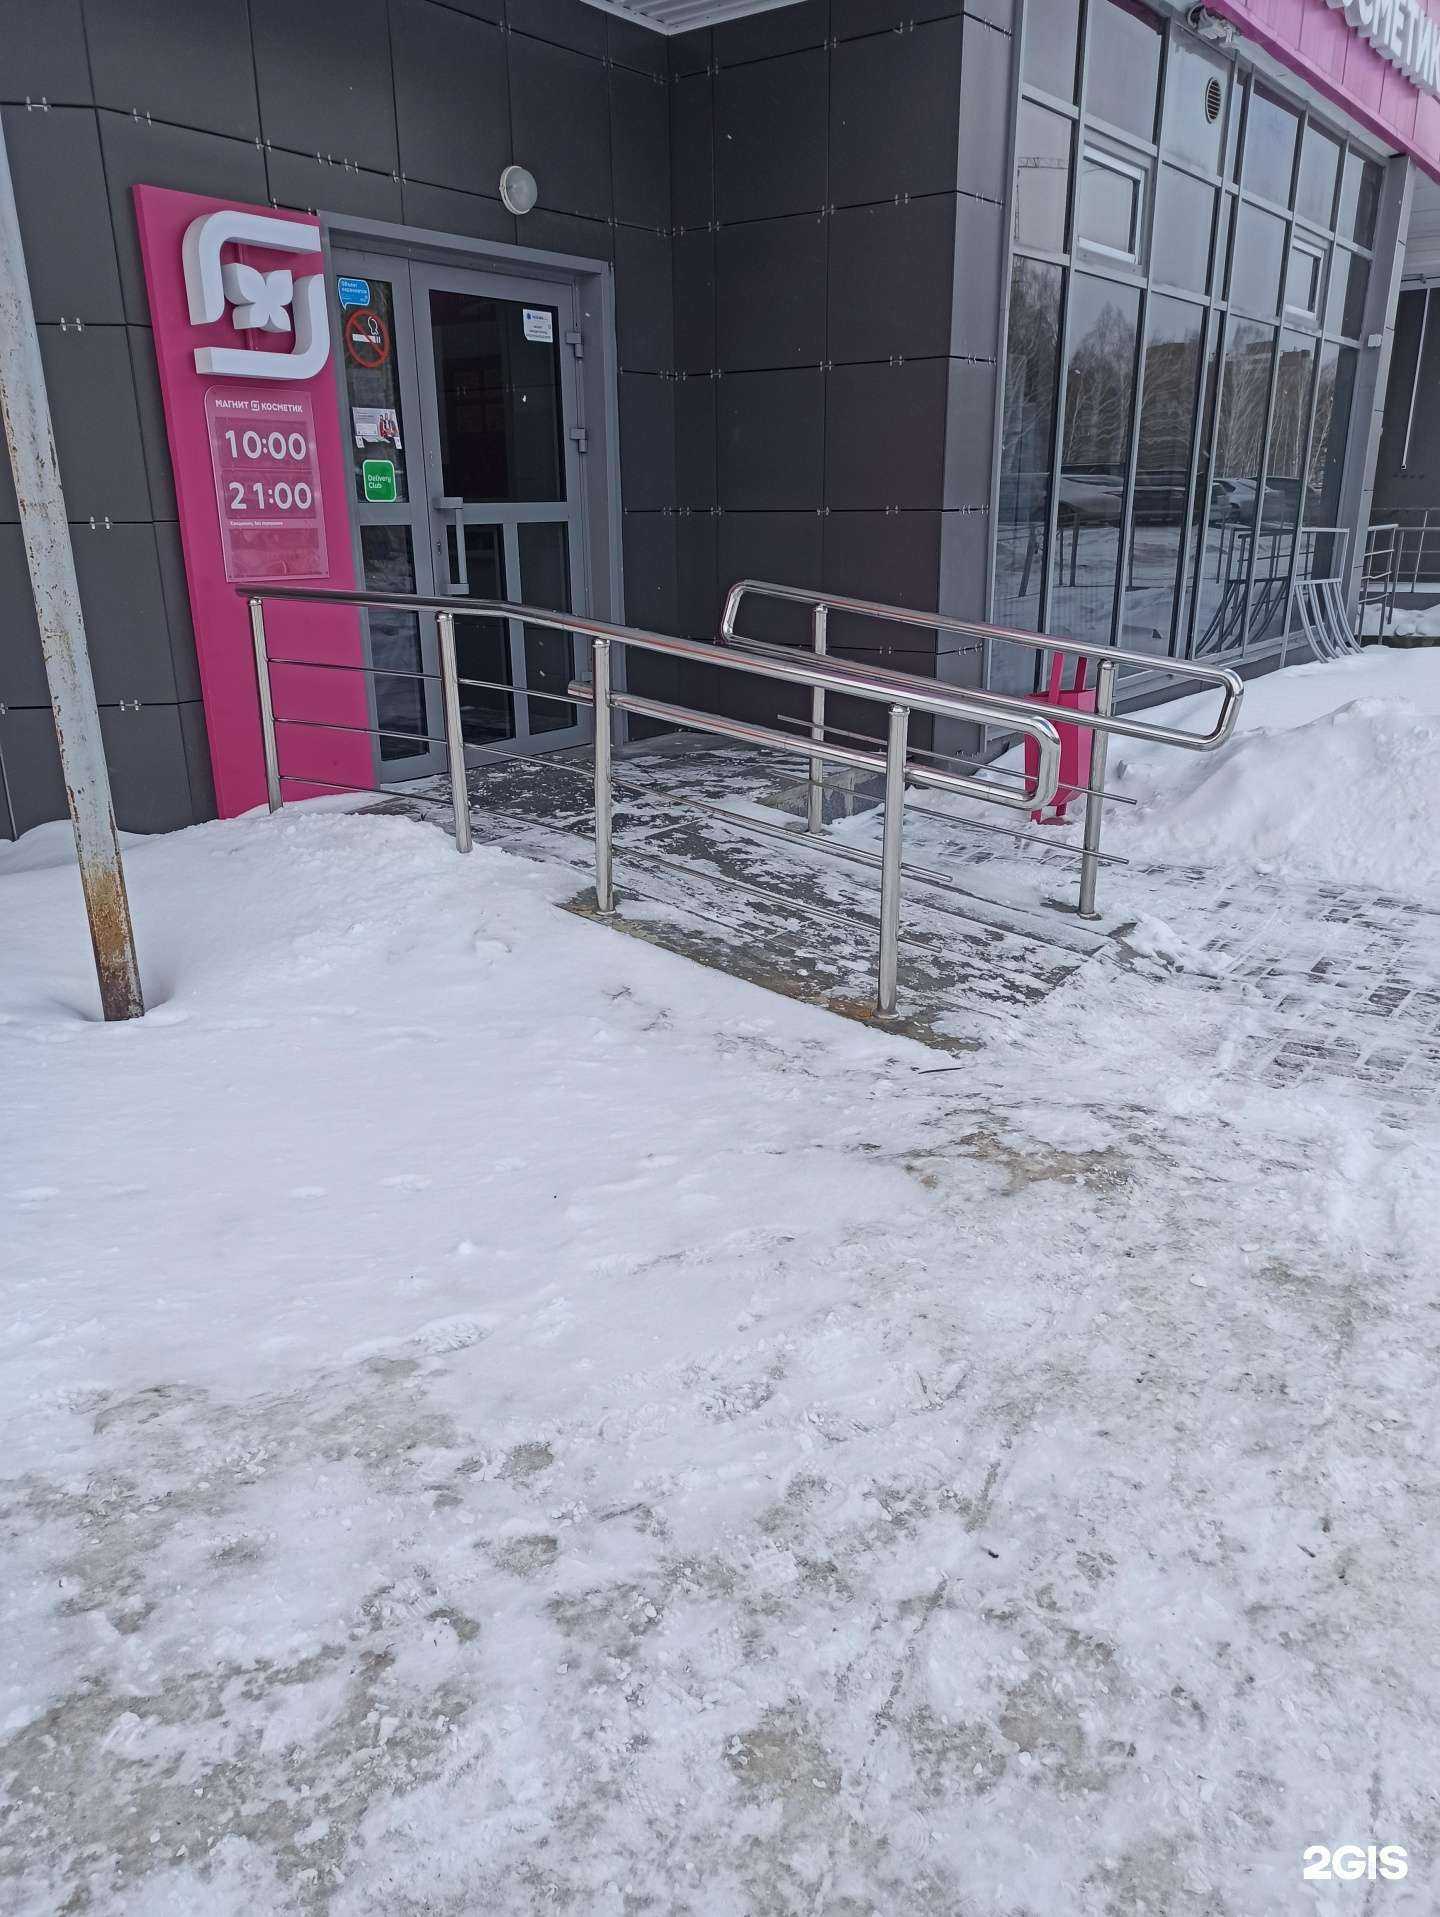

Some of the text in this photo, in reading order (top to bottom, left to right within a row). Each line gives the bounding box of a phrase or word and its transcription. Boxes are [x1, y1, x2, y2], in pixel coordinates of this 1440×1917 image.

[215, 399, 303, 413] МАГНИТ КОСМЕТИК
[225, 430, 307, 461] 10:00
[368, 474, 392, 483] Delivery
[229, 482, 312, 509] 21:00
